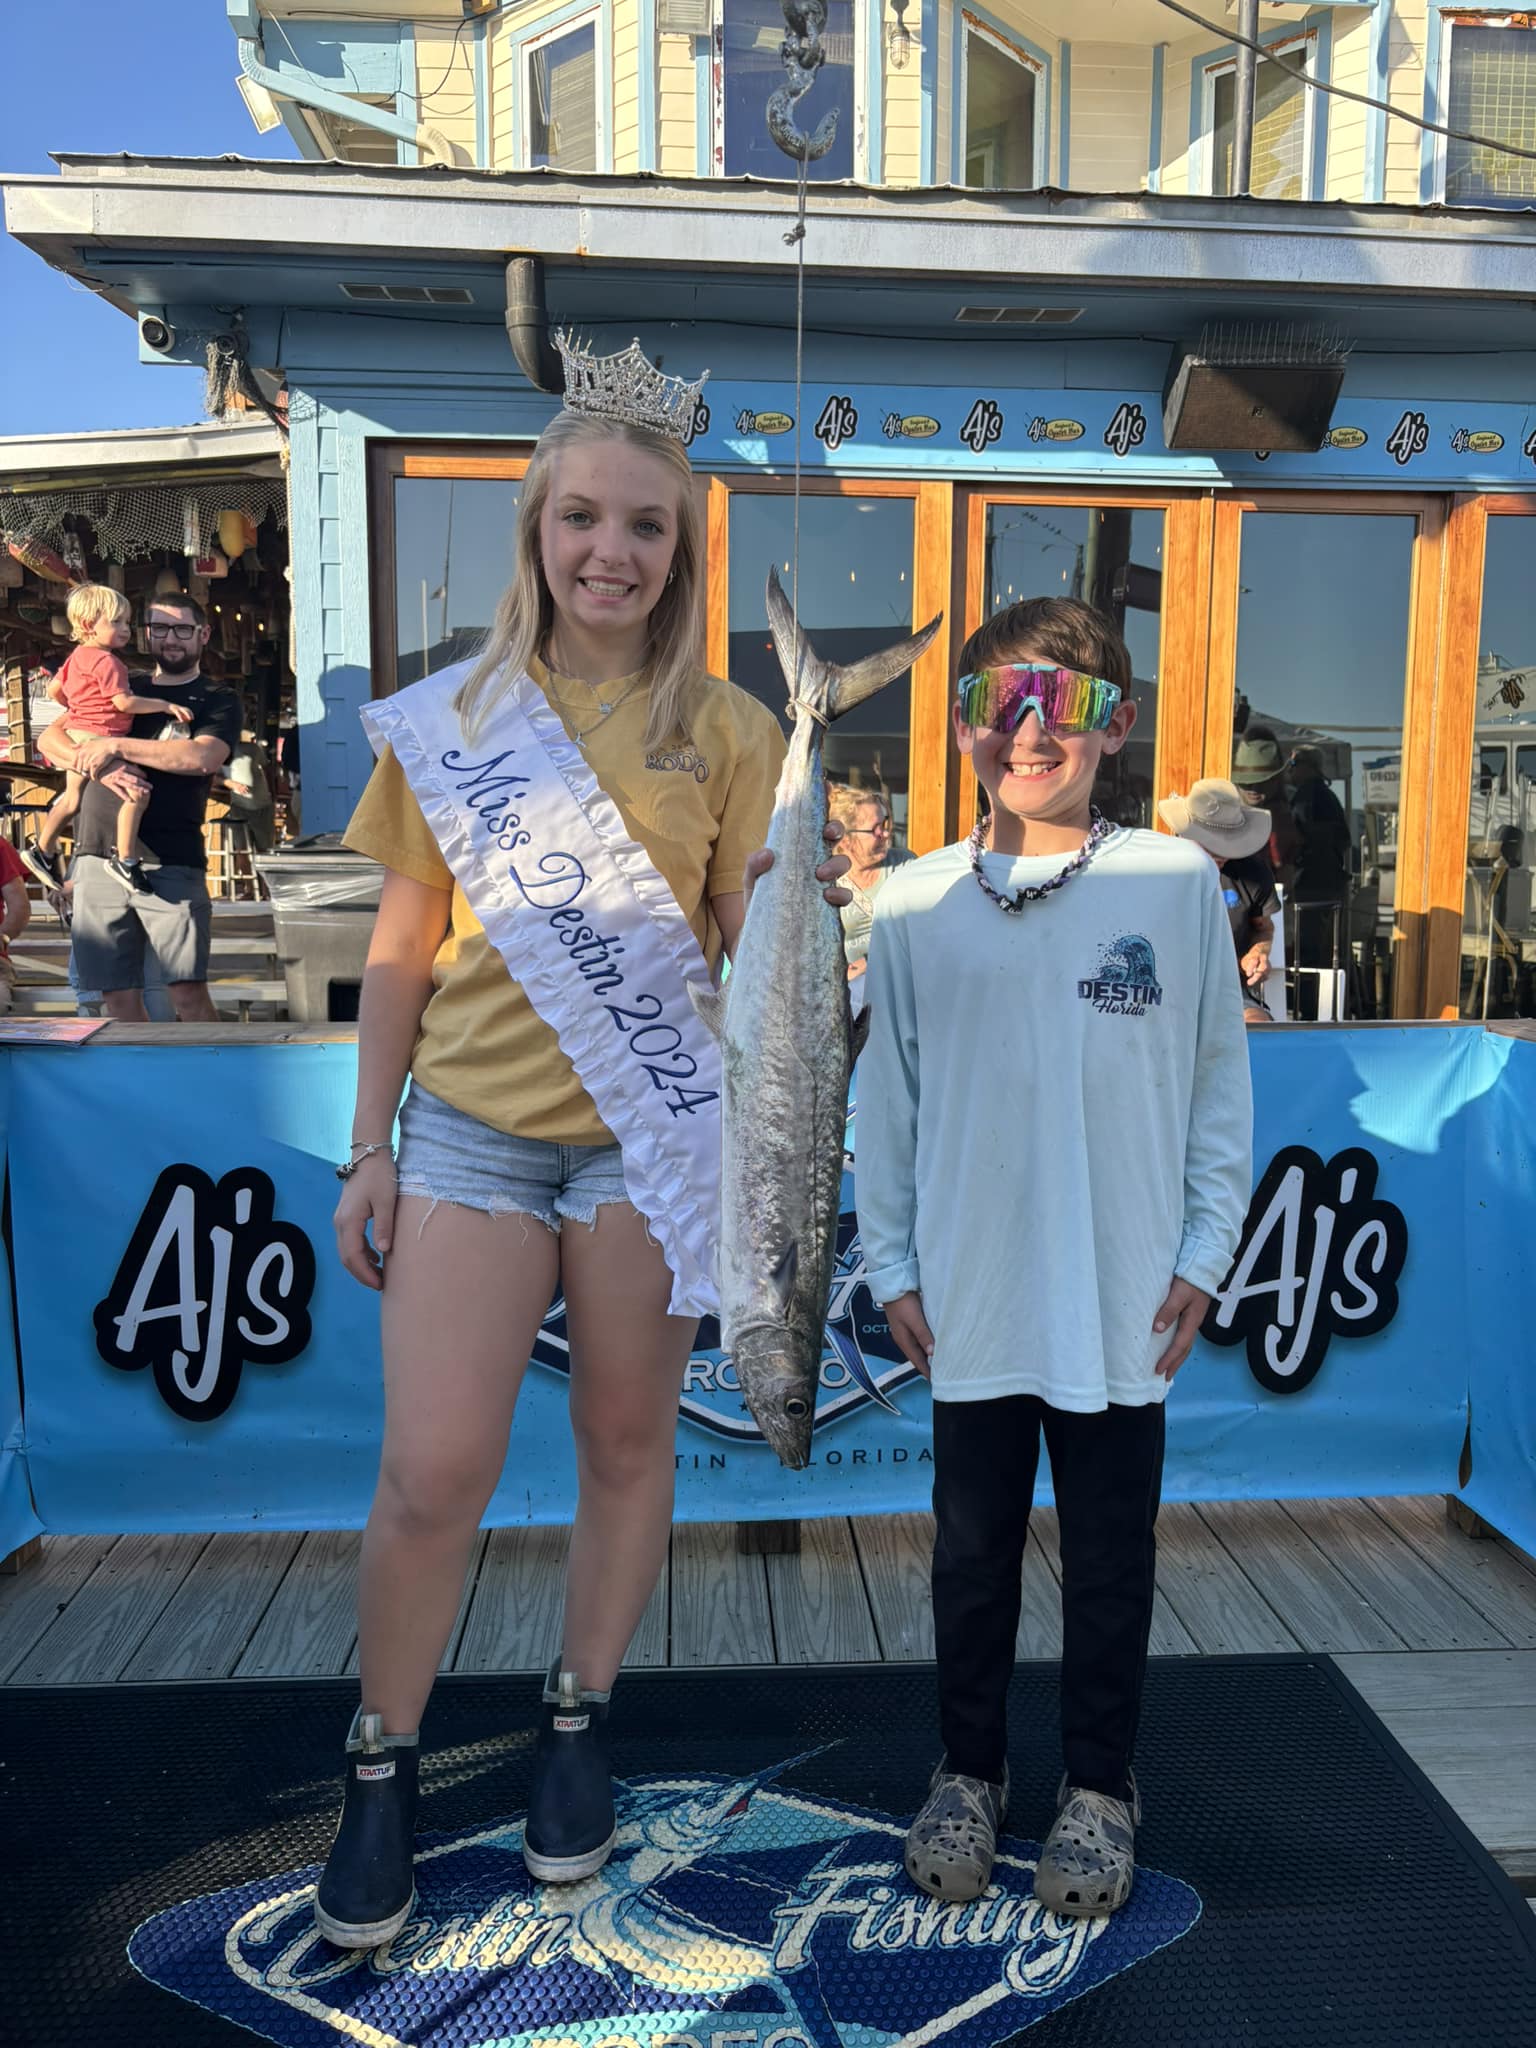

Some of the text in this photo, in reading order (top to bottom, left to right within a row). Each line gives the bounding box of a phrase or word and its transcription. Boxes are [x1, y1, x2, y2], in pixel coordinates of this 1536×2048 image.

[442, 750, 720, 1117] Miss Destin 2024
[1077, 980, 1163, 1006] DESTIN
[1092, 999, 1147, 1016] Florida
[682, 1357, 852, 1392] ROO
[675, 1447, 933, 1468] TIN ORIDA
